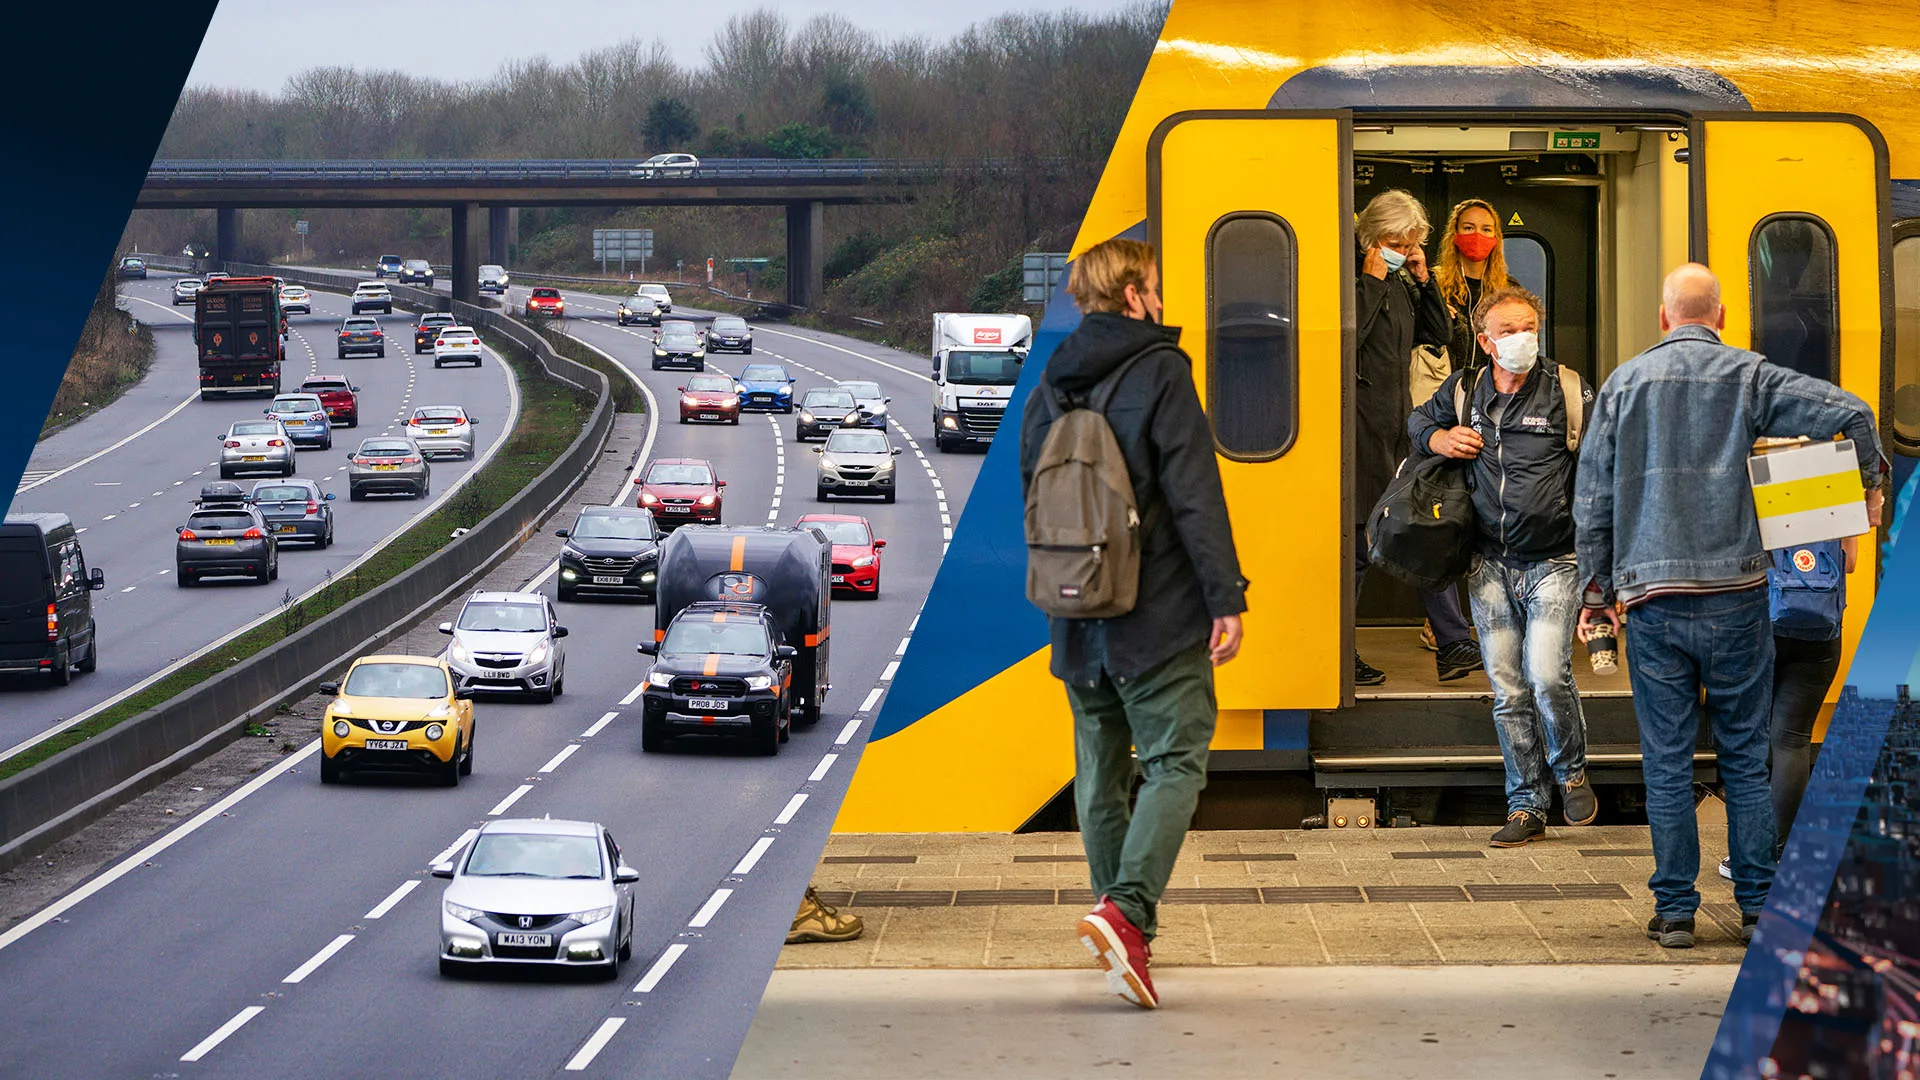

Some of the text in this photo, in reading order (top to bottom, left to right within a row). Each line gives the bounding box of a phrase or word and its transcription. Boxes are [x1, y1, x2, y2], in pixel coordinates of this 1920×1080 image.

[976, 331, 999, 339] Argos
[691, 700, 725, 709] PR08 JOS
[369, 741, 388, 749] YY64
[504, 934, 546, 945] WA13 YON
